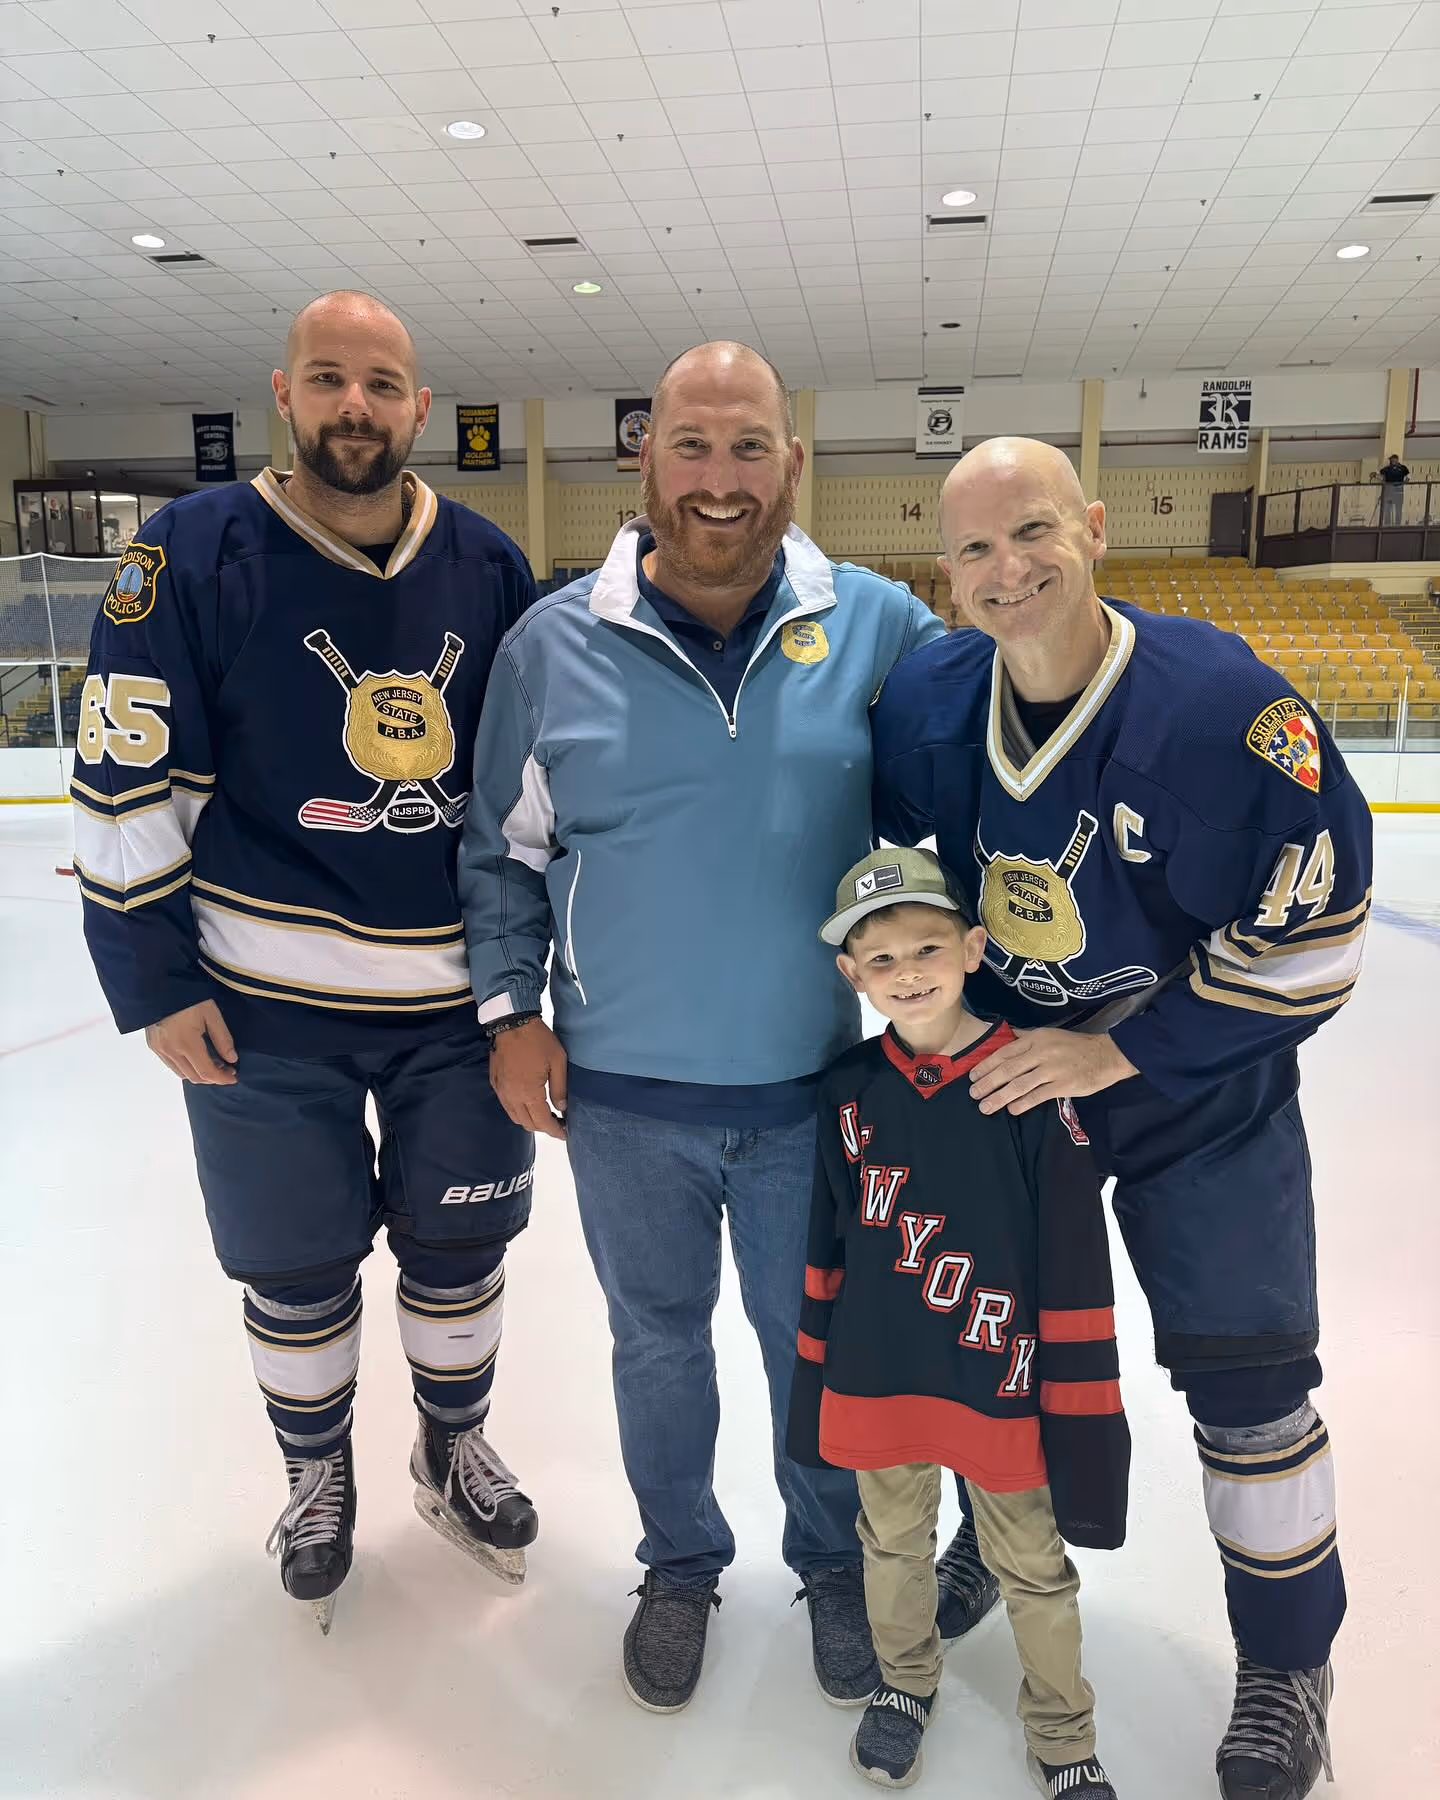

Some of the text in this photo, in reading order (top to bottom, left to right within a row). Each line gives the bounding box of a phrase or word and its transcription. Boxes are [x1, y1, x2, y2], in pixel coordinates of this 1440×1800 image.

[1203, 381, 1252, 391] RANDOLPH
[1199, 432, 1247, 450] RAMS
[900, 503, 921, 521] 14
[1151, 496, 1173, 515] 15
[121, 551, 155, 571] EDISON
[107, 594, 142, 614] POLICE
[372, 689, 423, 703] NEW JERSEY
[77, 673, 171, 768] 65
[382, 704, 418, 723] STATE
[1251, 701, 1297, 744] SHERIFF
[384, 726, 424, 739] P.B.A.
[392, 806, 431, 816] NJSPBA
[1113, 802, 1152, 864] C
[1003, 872, 1048, 889] NEW JERSEY
[1254, 829, 1336, 926] 44
[1012, 884, 1045, 909] STATE
[1014, 906, 1050, 921] P.B.A.
[1021, 980, 1059, 993] NJSPBA
